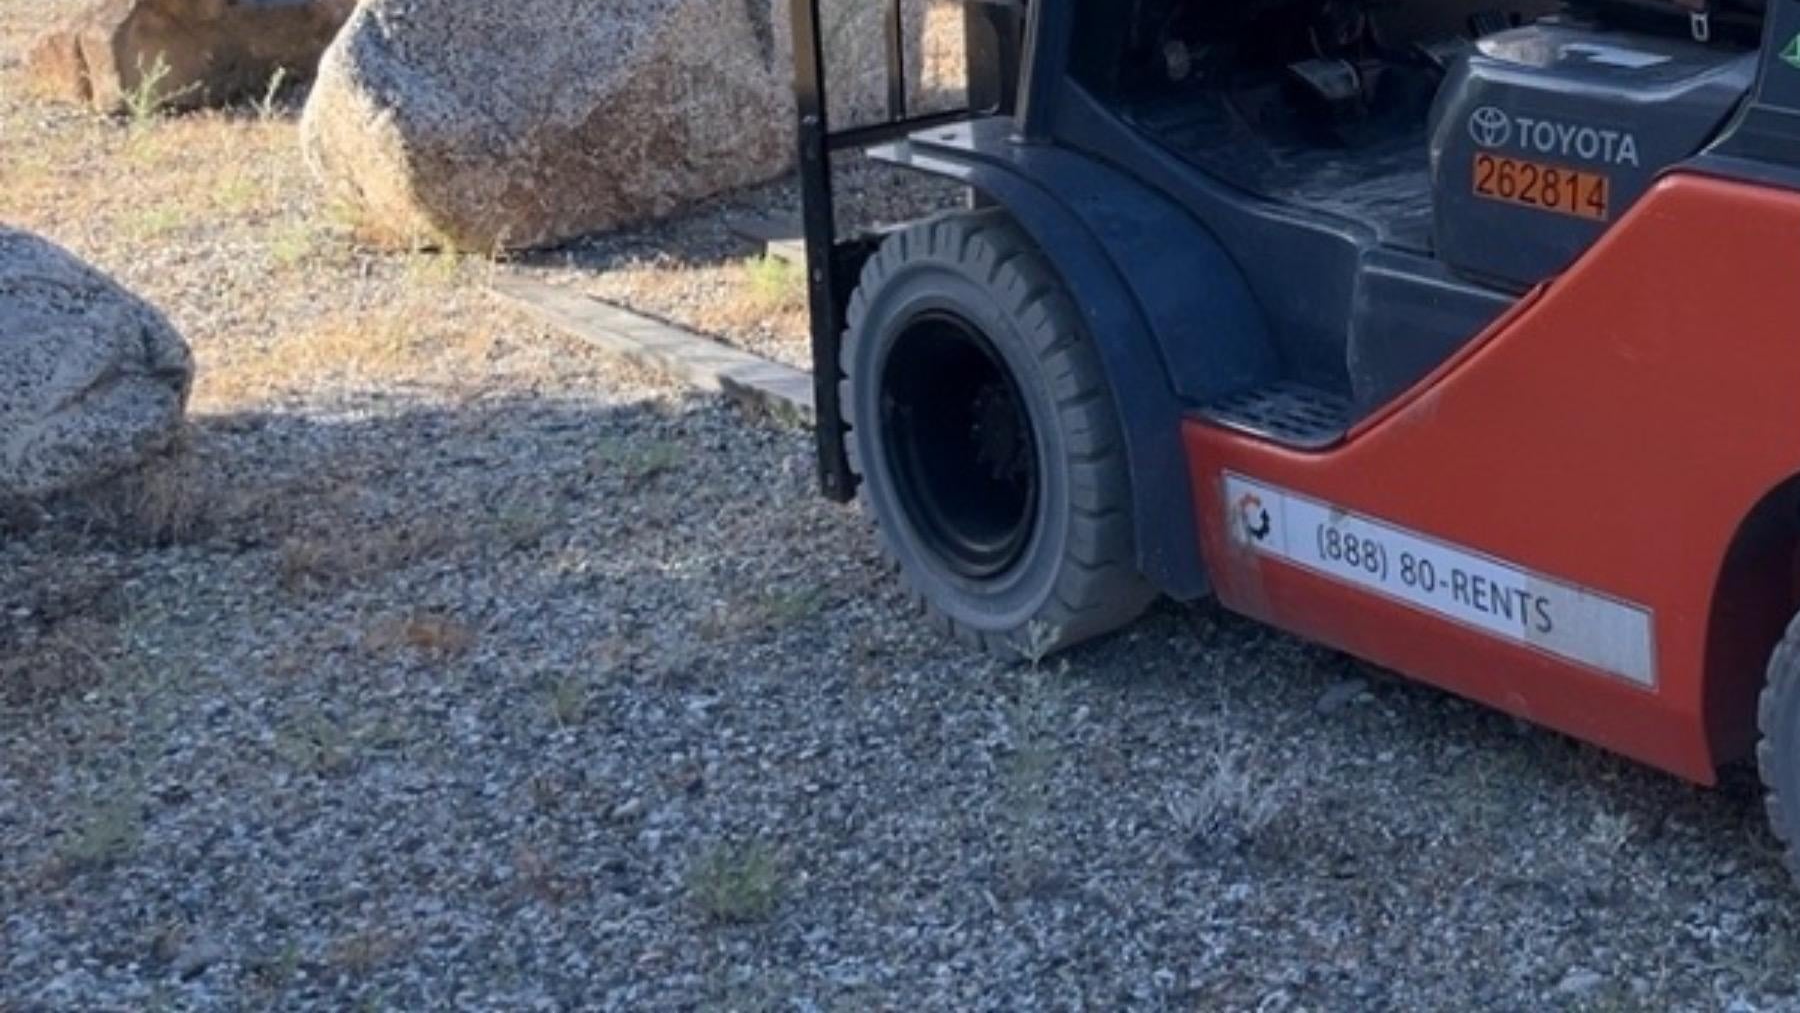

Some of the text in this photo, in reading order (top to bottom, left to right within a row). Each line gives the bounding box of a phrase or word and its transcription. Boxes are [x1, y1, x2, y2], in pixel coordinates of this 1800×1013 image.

[1515, 117, 1640, 167] TOYOTA
[1477, 154, 1606, 216] 262814
[1316, 522, 1553, 634] (888) 80-RENTS
